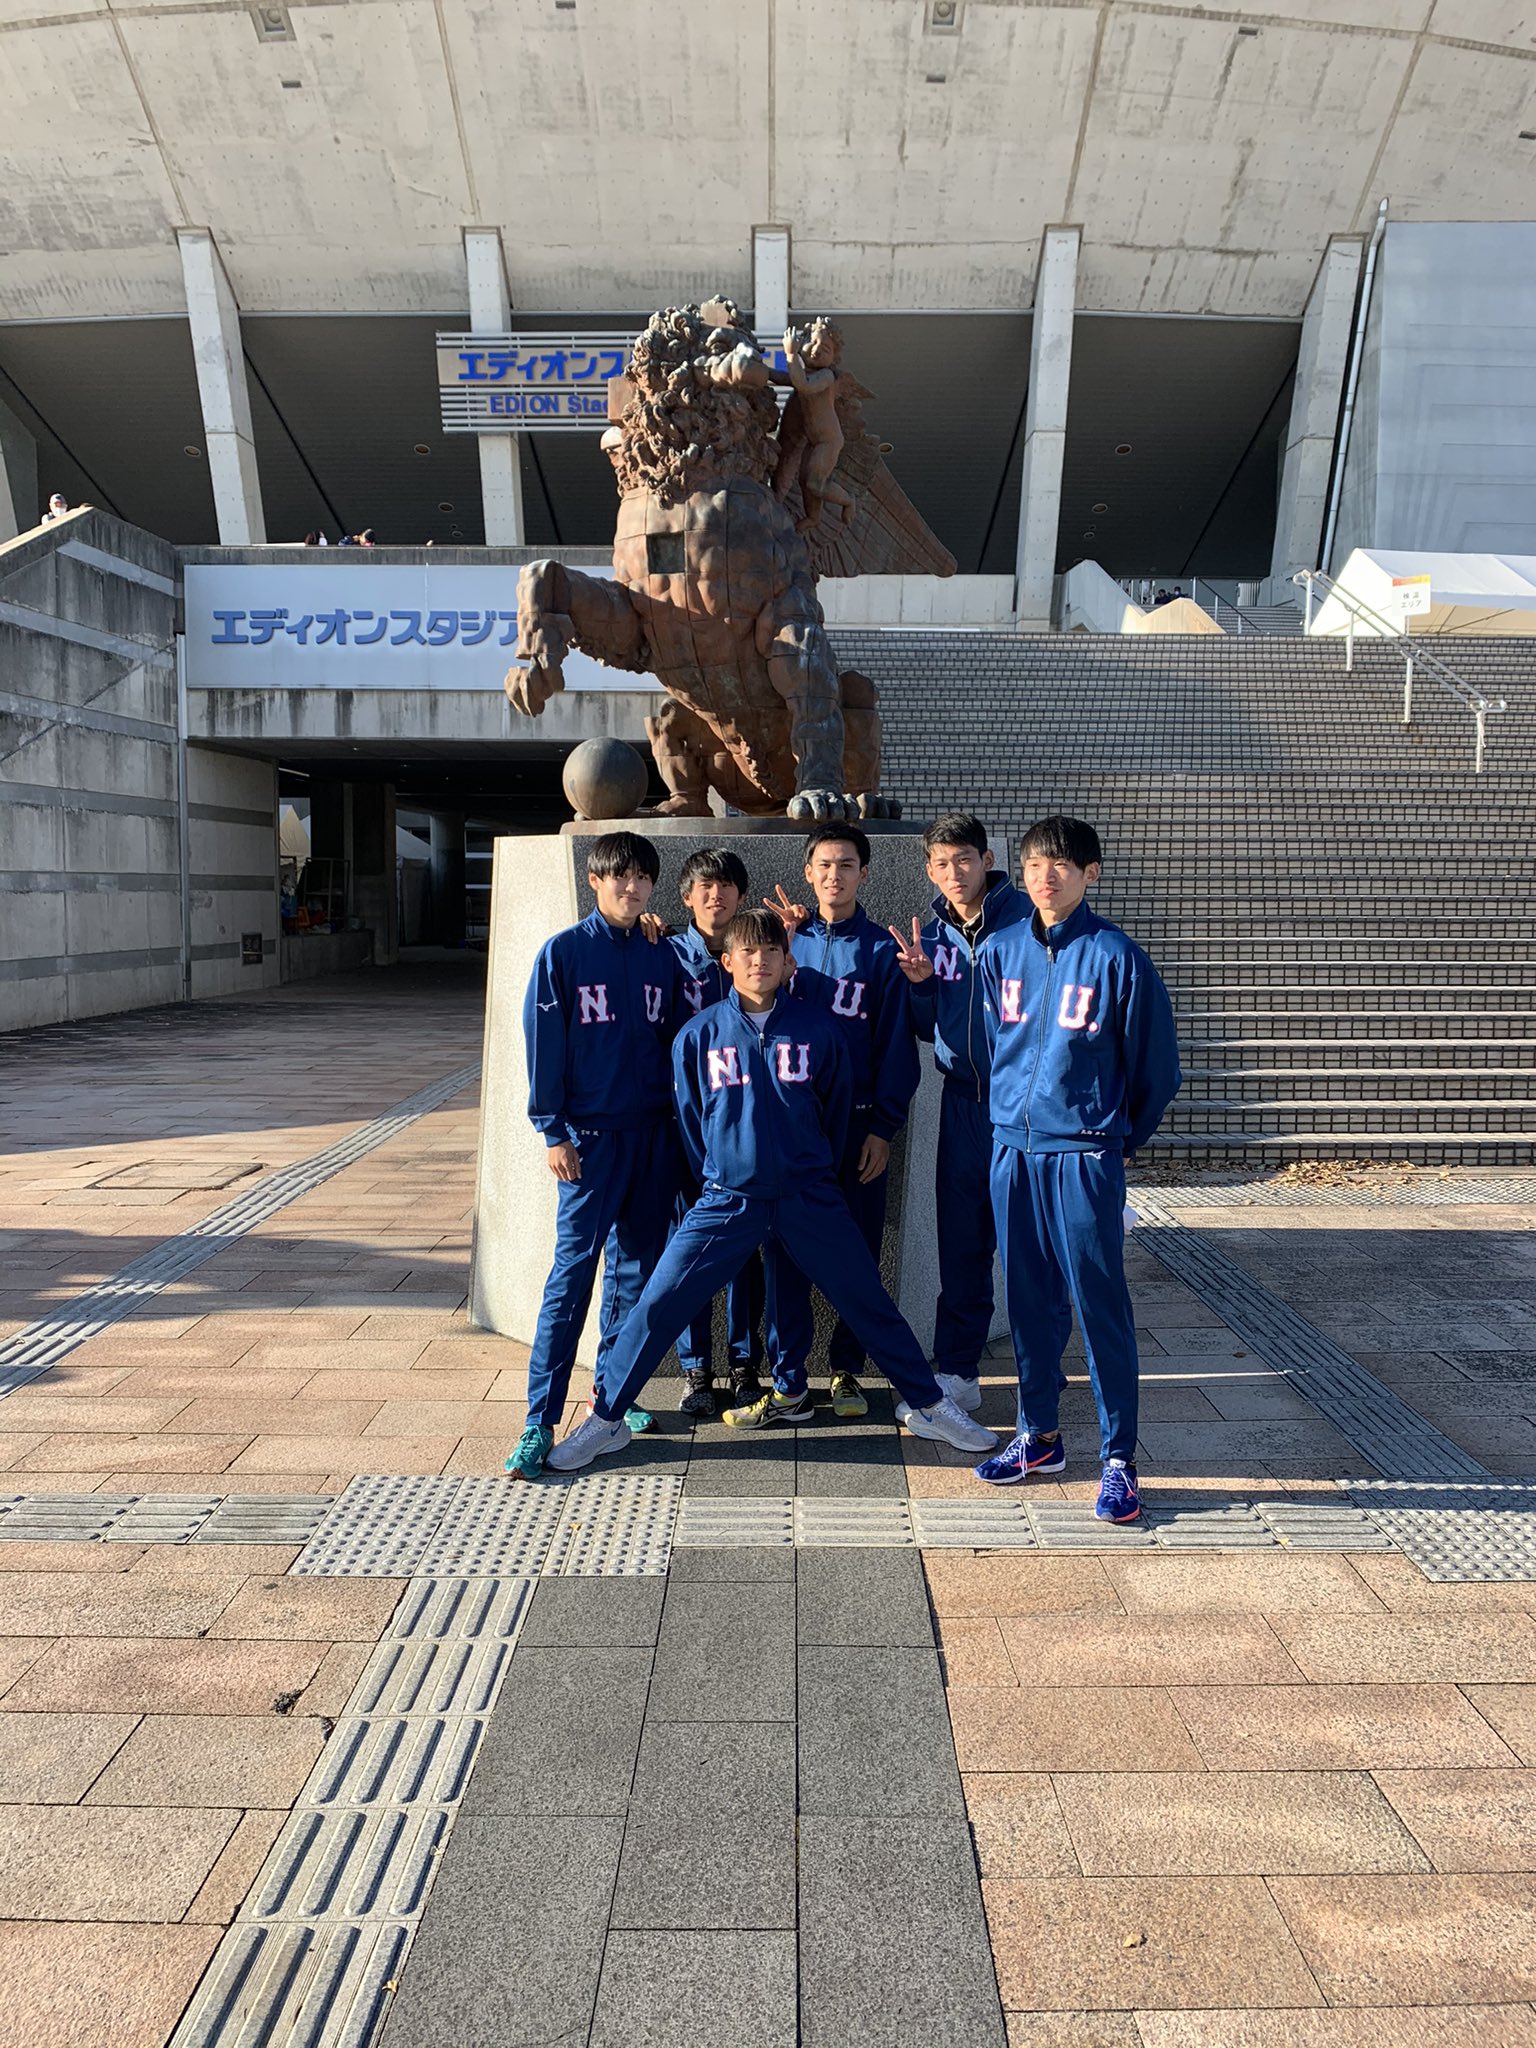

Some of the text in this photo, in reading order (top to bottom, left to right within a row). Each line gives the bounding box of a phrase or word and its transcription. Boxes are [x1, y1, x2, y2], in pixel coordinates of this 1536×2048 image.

[458, 351, 632, 380] エディオンス
[490, 395, 560, 414] EDION
[933, 943, 962, 981] N.
[577, 984, 616, 1024] N.
[831, 977, 868, 1019] U.
[1058, 984, 1099, 1032] U.
[707, 1046, 752, 1089] N.
